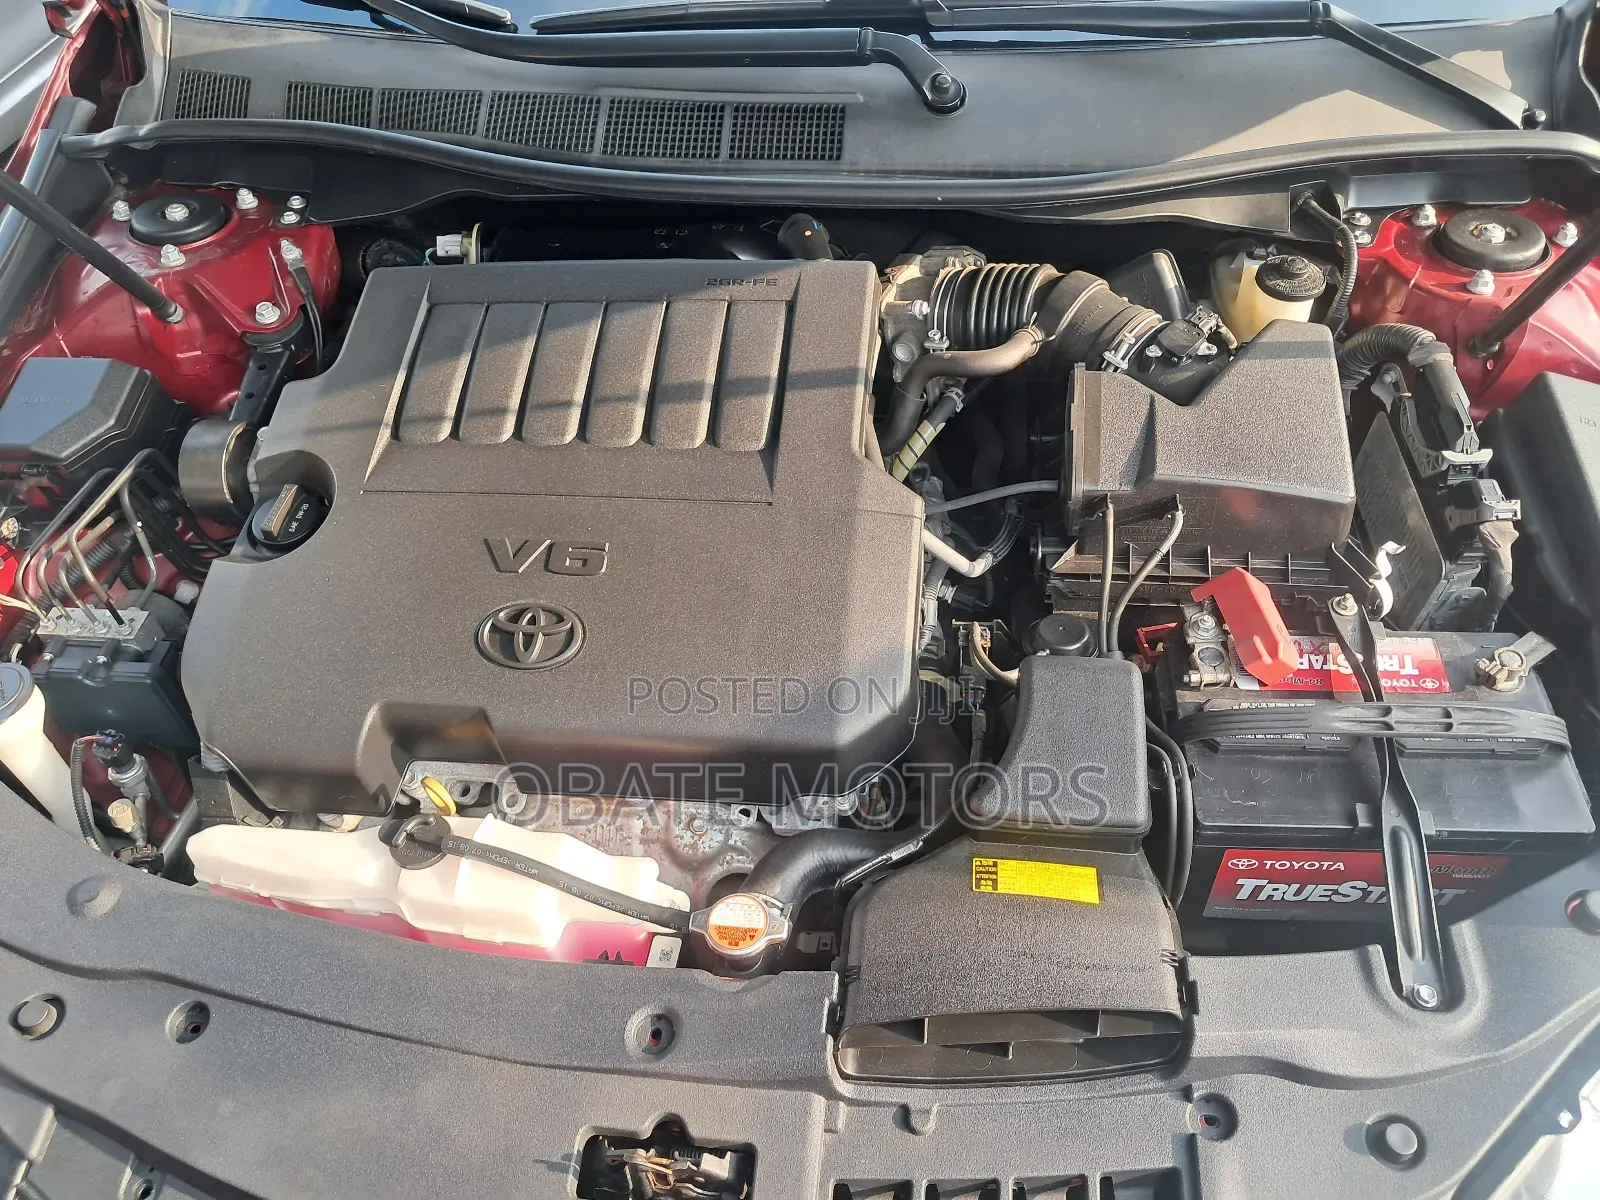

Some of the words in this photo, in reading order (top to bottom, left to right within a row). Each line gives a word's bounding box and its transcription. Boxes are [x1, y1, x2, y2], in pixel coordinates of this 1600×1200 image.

[705, 278, 778, 286] 2GR-FE
[288, 521, 299, 533] SAE
[483, 538, 609, 576] V6
[1381, 679, 1419, 688] TOYO
[515, 861, 539, 876] WATER
[1263, 860, 1346, 871] TOYOTA
[627, 909, 650, 922] WATER
